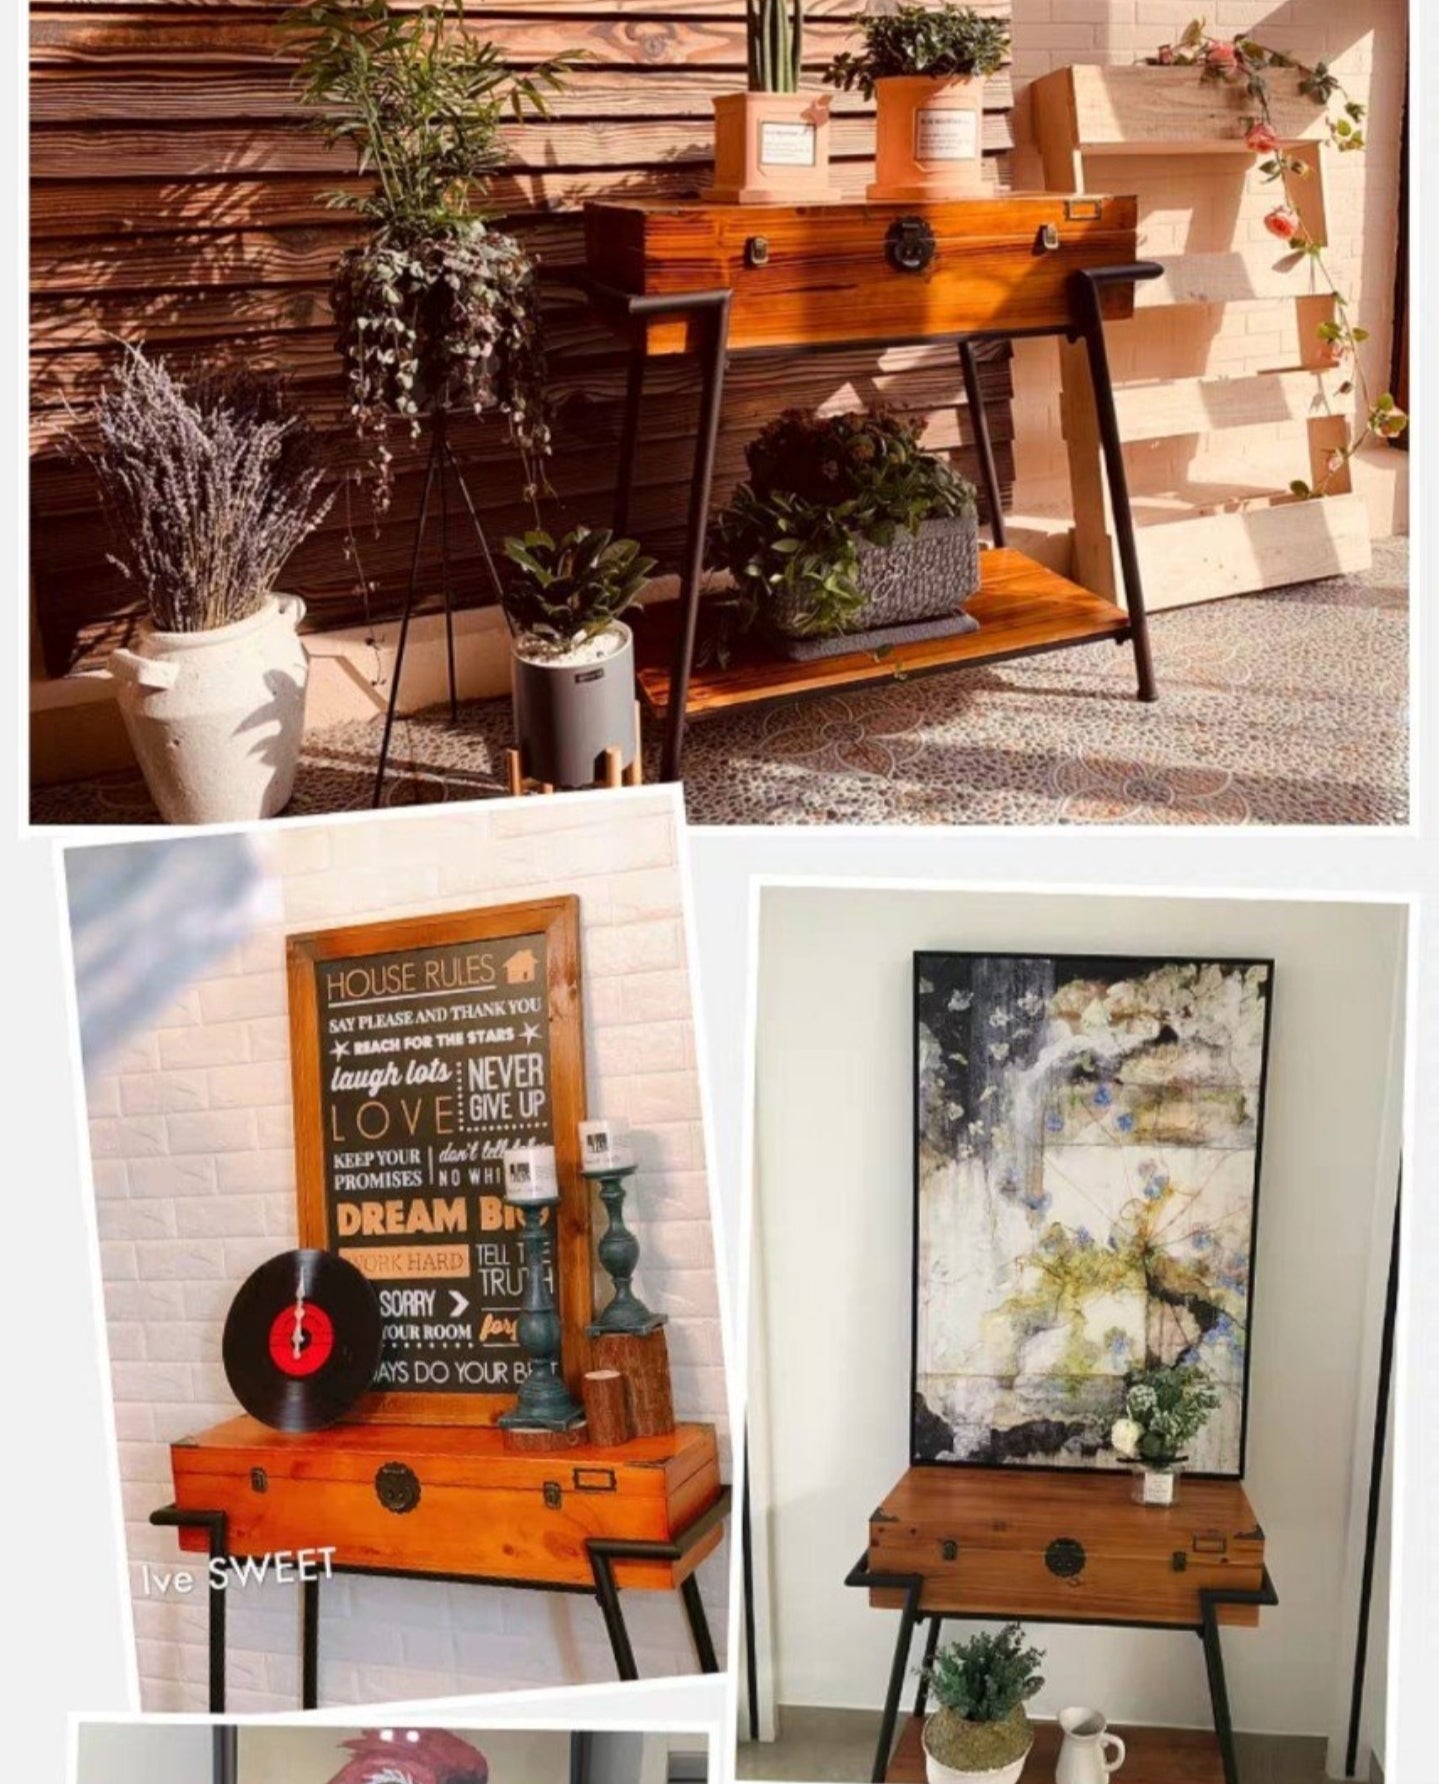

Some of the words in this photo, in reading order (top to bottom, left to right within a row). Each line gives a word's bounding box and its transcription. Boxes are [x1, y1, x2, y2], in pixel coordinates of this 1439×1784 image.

[325, 962, 416, 1000] HOUSE
[424, 953, 496, 989] RULES
[329, 1017, 355, 1034] SAY
[358, 1010, 414, 1030] PLEASE
[415, 1007, 447, 1024] AND
[450, 1002, 507, 1021] THANK
[508, 998, 542, 1014] YOU
[353, 1039, 400, 1055] REACH
[404, 1036, 433, 1050] FOR
[436, 1032, 464, 1047] THE
[467, 1027, 515, 1043] STARS
[331, 1060, 402, 1097] laugh
[405, 1057, 452, 1085] lots
[468, 1052, 544, 1092] NEVER
[331, 1096, 454, 1142] LOVE
[469, 1092, 513, 1121] GIVE
[519, 1089, 545, 1119] UP
[333, 1151, 375, 1169] KEEP
[376, 1148, 421, 1167] YOUR
[438, 1141, 480, 1163] don't
[334, 1170, 424, 1191] PROMISES
[438, 1167, 460, 1187] NO
[336, 1197, 468, 1236] DREAM
[407, 1251, 464, 1271] HARD
[475, 1243, 511, 1266] TELL
[516, 1241, 552, 1264] TE
[378, 1289, 436, 1318] SORRY
[422, 1323, 473, 1340] ROOM
[373, 1360, 410, 1383] AYS
[414, 1360, 450, 1384] DO
[454, 1360, 508, 1384] YOUR
